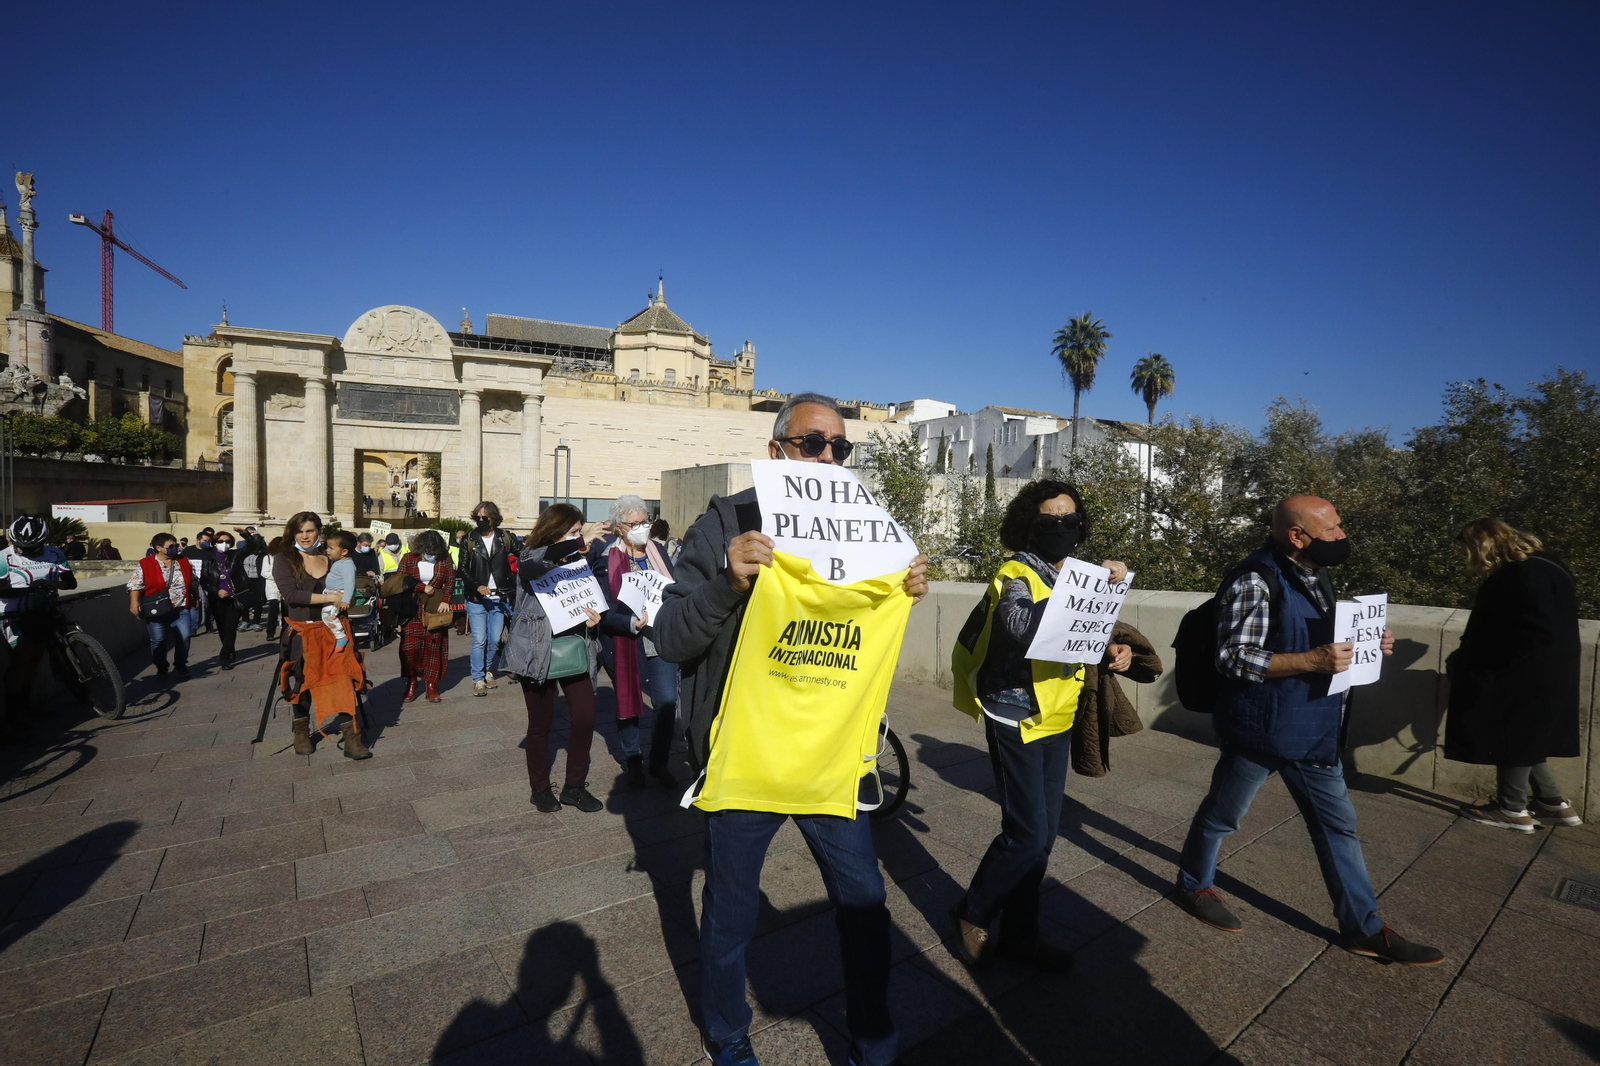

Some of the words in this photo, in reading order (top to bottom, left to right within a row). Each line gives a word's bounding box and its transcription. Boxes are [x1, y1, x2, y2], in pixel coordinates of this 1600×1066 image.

[782, 475, 822, 501] NO
[830, 480, 880, 506] HA
[772, 512, 903, 543] PLANETA
[536, 579, 550, 591] NI
[562, 565, 588, 579] GRADO
[827, 557, 846, 581] B
[547, 584, 569, 600] MÁS
[574, 575, 593, 588] UNA
[1066, 570, 1091, 590] NI
[1115, 581, 1129, 596] G
[560, 587, 594, 608] ESPECIE
[568, 599, 598, 619] MENOS
[1065, 595, 1103, 614] MÁS
[1102, 602, 1119, 615] NI
[1367, 604, 1386, 620] DE
[1068, 619, 1114, 635] ESPEC
[768, 645, 858, 671] INTERNACIONAL
